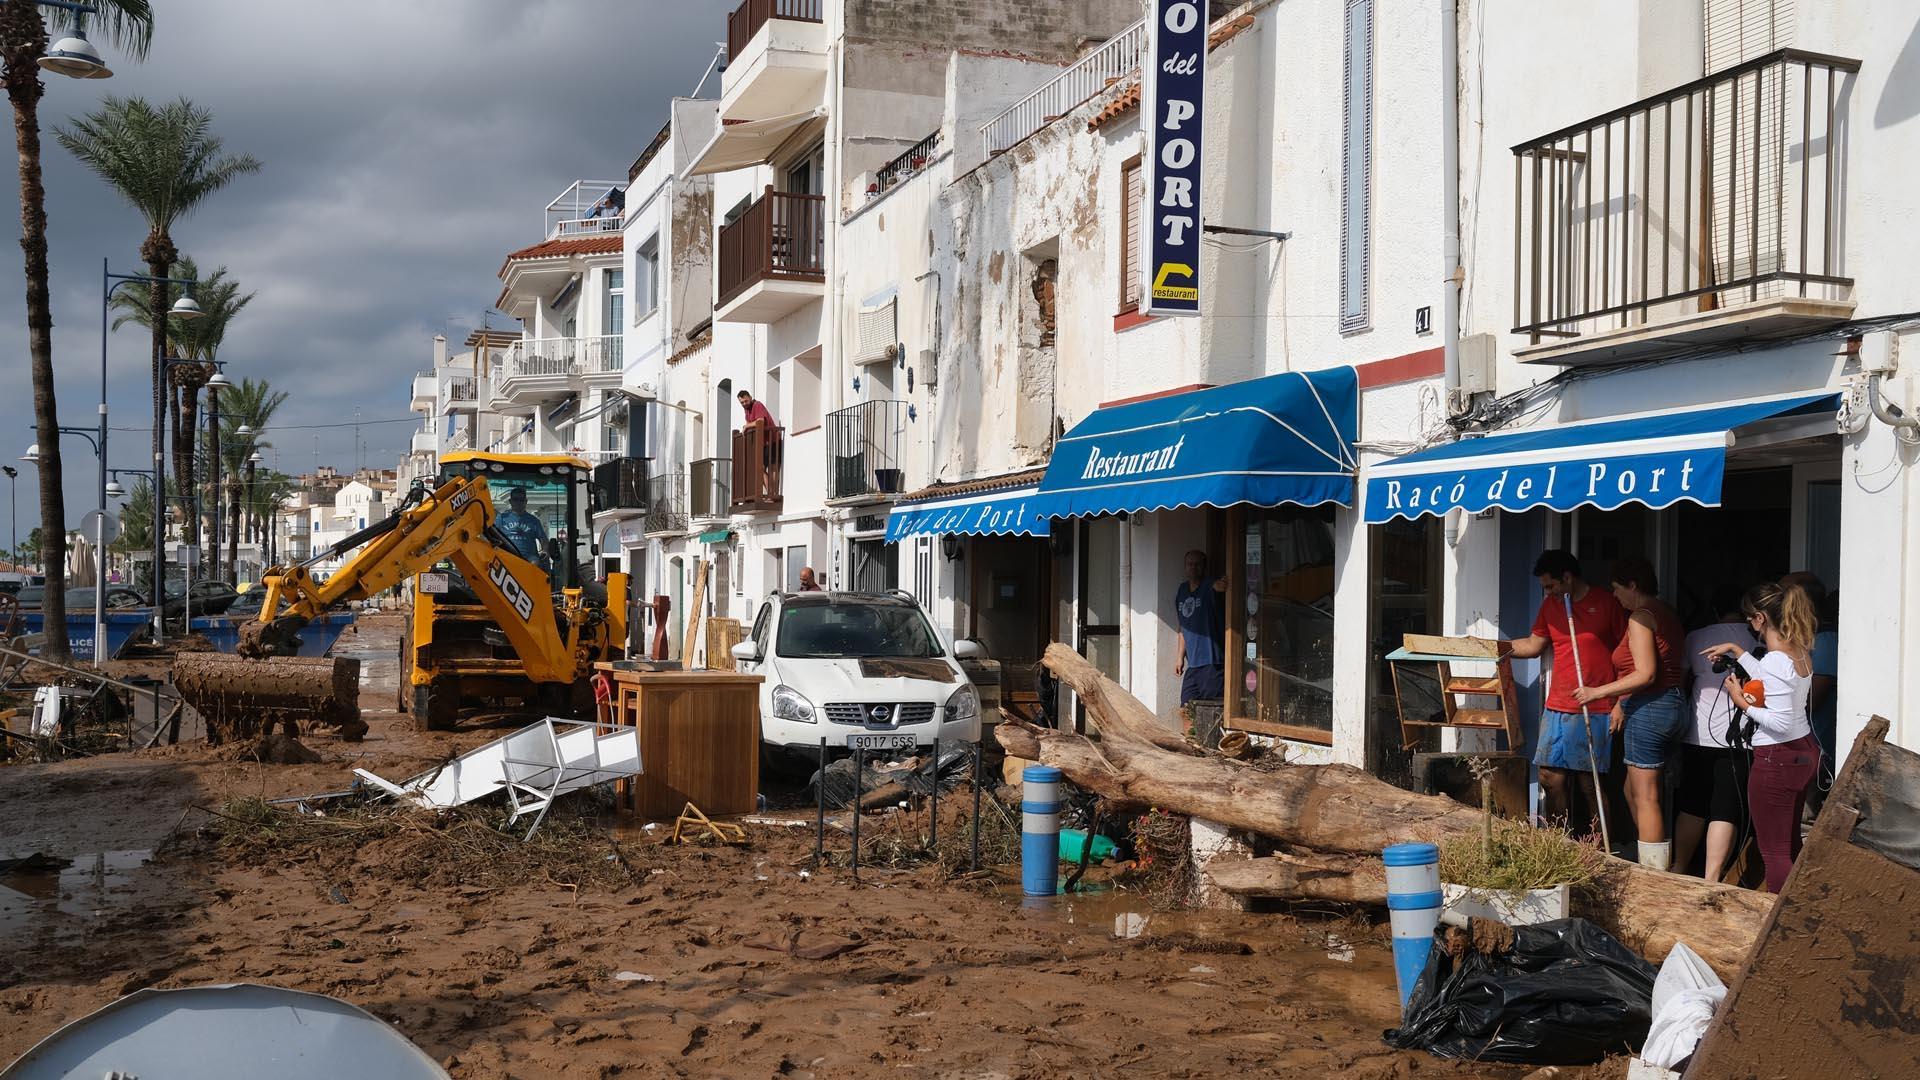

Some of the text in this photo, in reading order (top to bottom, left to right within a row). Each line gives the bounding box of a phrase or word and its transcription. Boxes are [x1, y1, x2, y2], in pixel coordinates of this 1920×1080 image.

[1162, 51, 1198, 75] del
[1159, 99, 1195, 246] PORT
[1153, 289, 1196, 299] restaurant
[1080, 433, 1185, 480] Restaurant
[1385, 458, 1694, 510] Racó del Port
[933, 506, 970, 529] del
[974, 502, 1026, 528] Port
[490, 563, 533, 621] JCB
[856, 736, 914, 748] 9017 GSS
